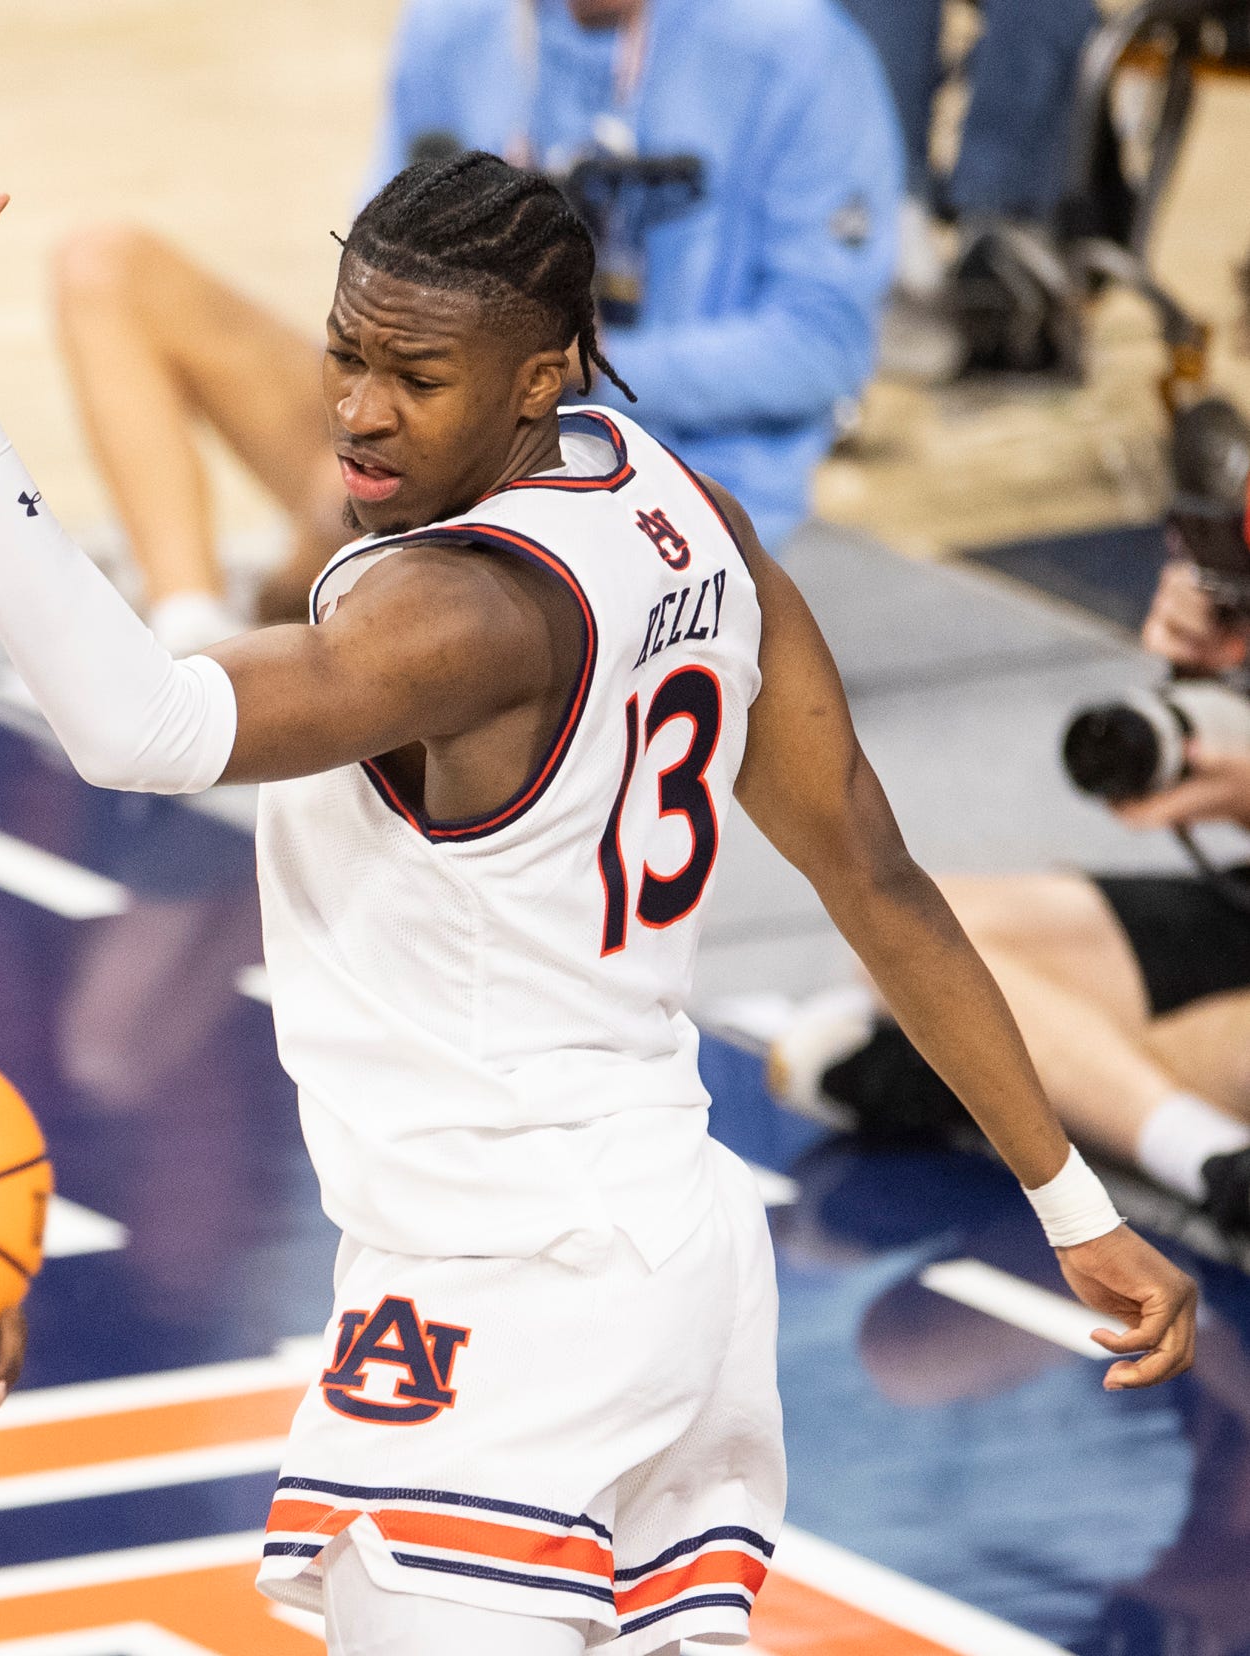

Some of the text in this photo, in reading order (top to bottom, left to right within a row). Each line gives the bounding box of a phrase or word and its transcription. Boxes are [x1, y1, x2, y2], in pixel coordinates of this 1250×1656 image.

[632, 568, 726, 671] KELLY
[599, 664, 722, 958] 13
[319, 1294, 472, 1426] AU
